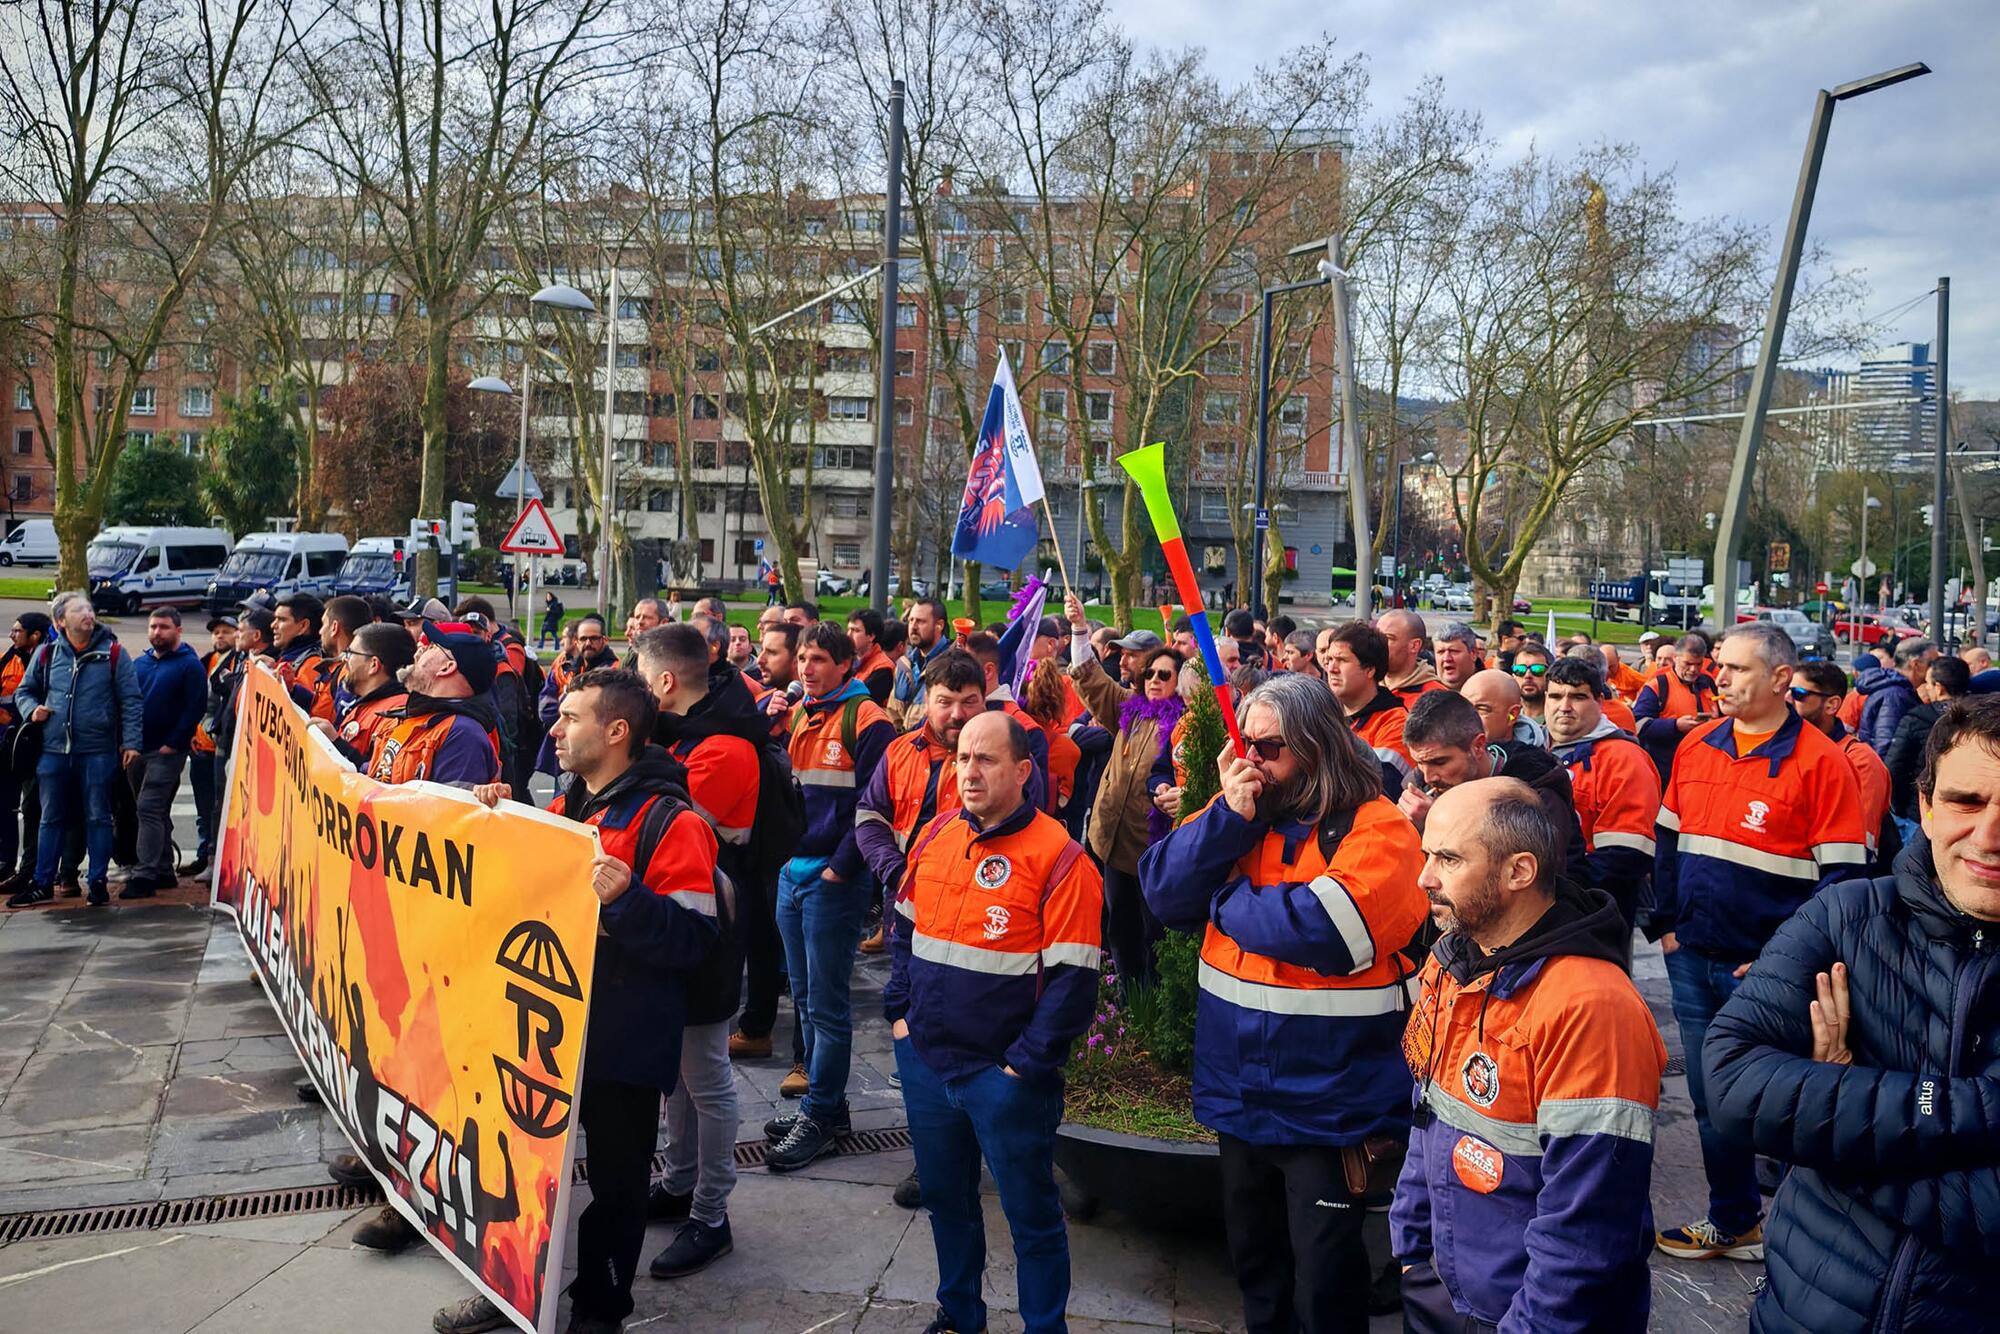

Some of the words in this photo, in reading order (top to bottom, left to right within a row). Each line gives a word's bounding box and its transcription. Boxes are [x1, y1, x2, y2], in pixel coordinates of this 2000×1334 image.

[309, 780, 475, 907] ORROKAN
[1917, 1081, 1935, 1116] altus
[376, 1086, 477, 1249] EZ!!
